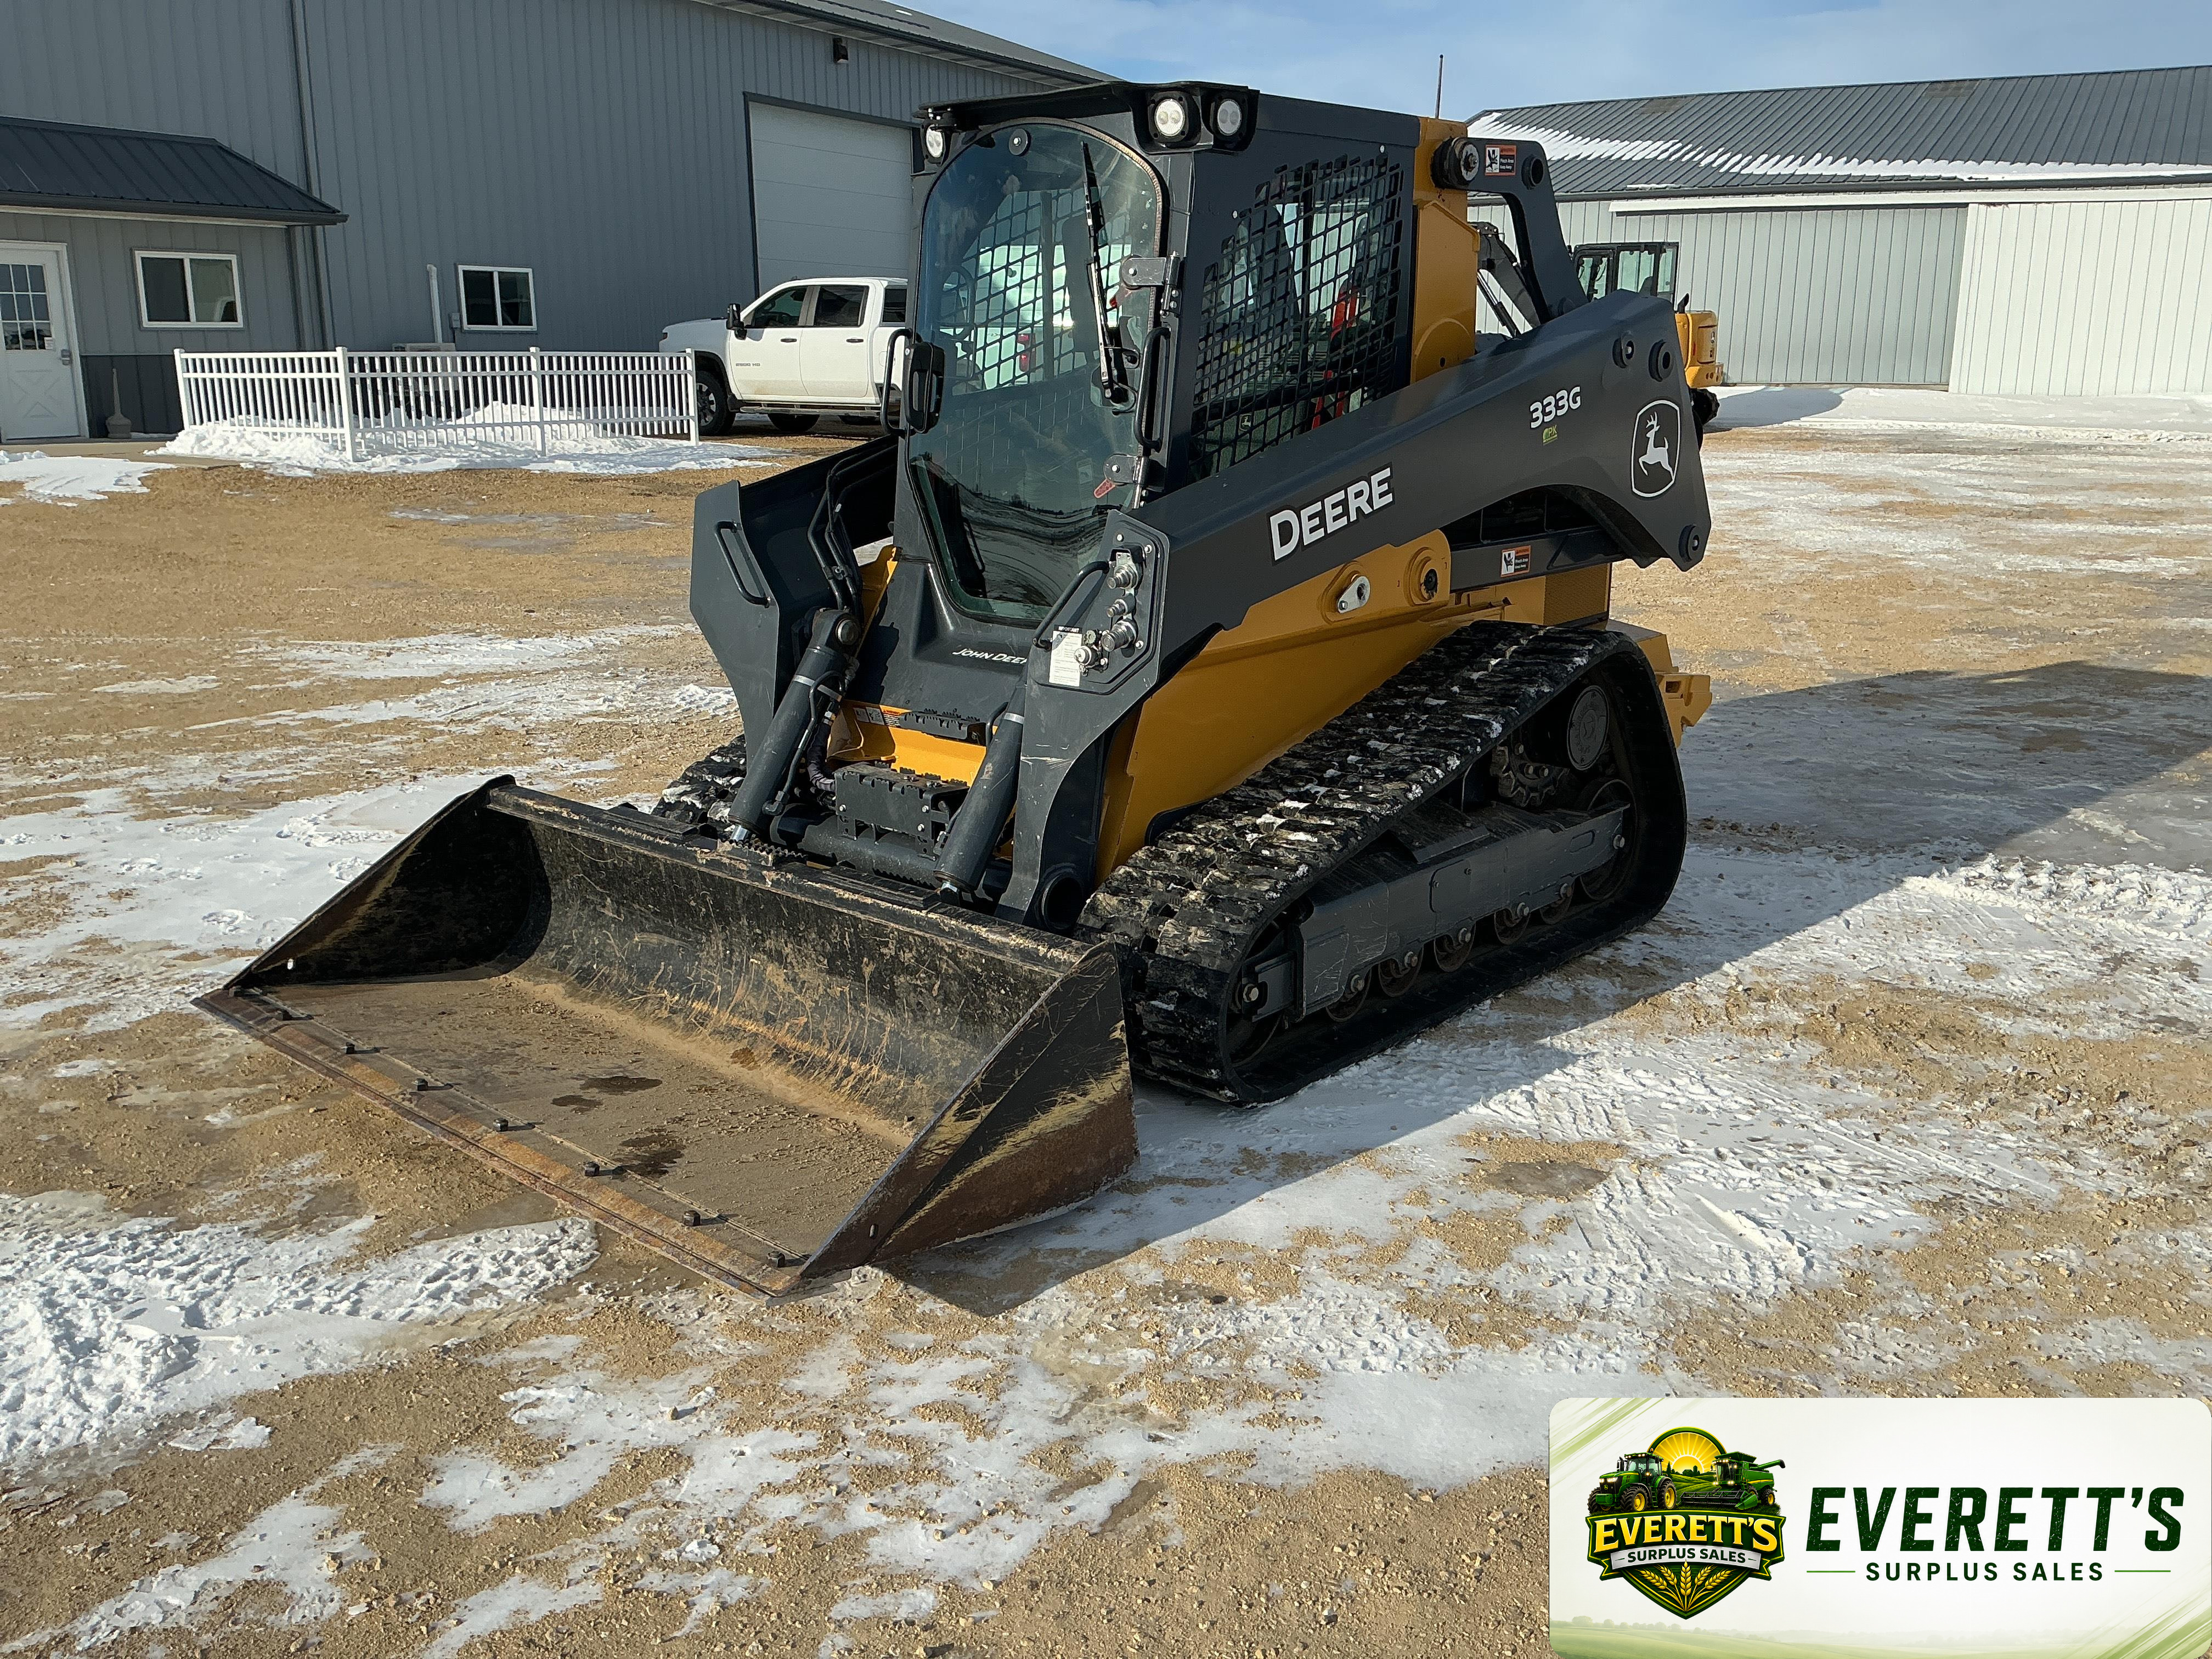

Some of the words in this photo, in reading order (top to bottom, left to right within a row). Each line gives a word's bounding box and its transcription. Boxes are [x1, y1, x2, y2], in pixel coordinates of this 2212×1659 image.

[1530, 386, 1581, 428] 333G
[1269, 467, 1393, 561] DEERE
[952, 648, 995, 659] JOHN
